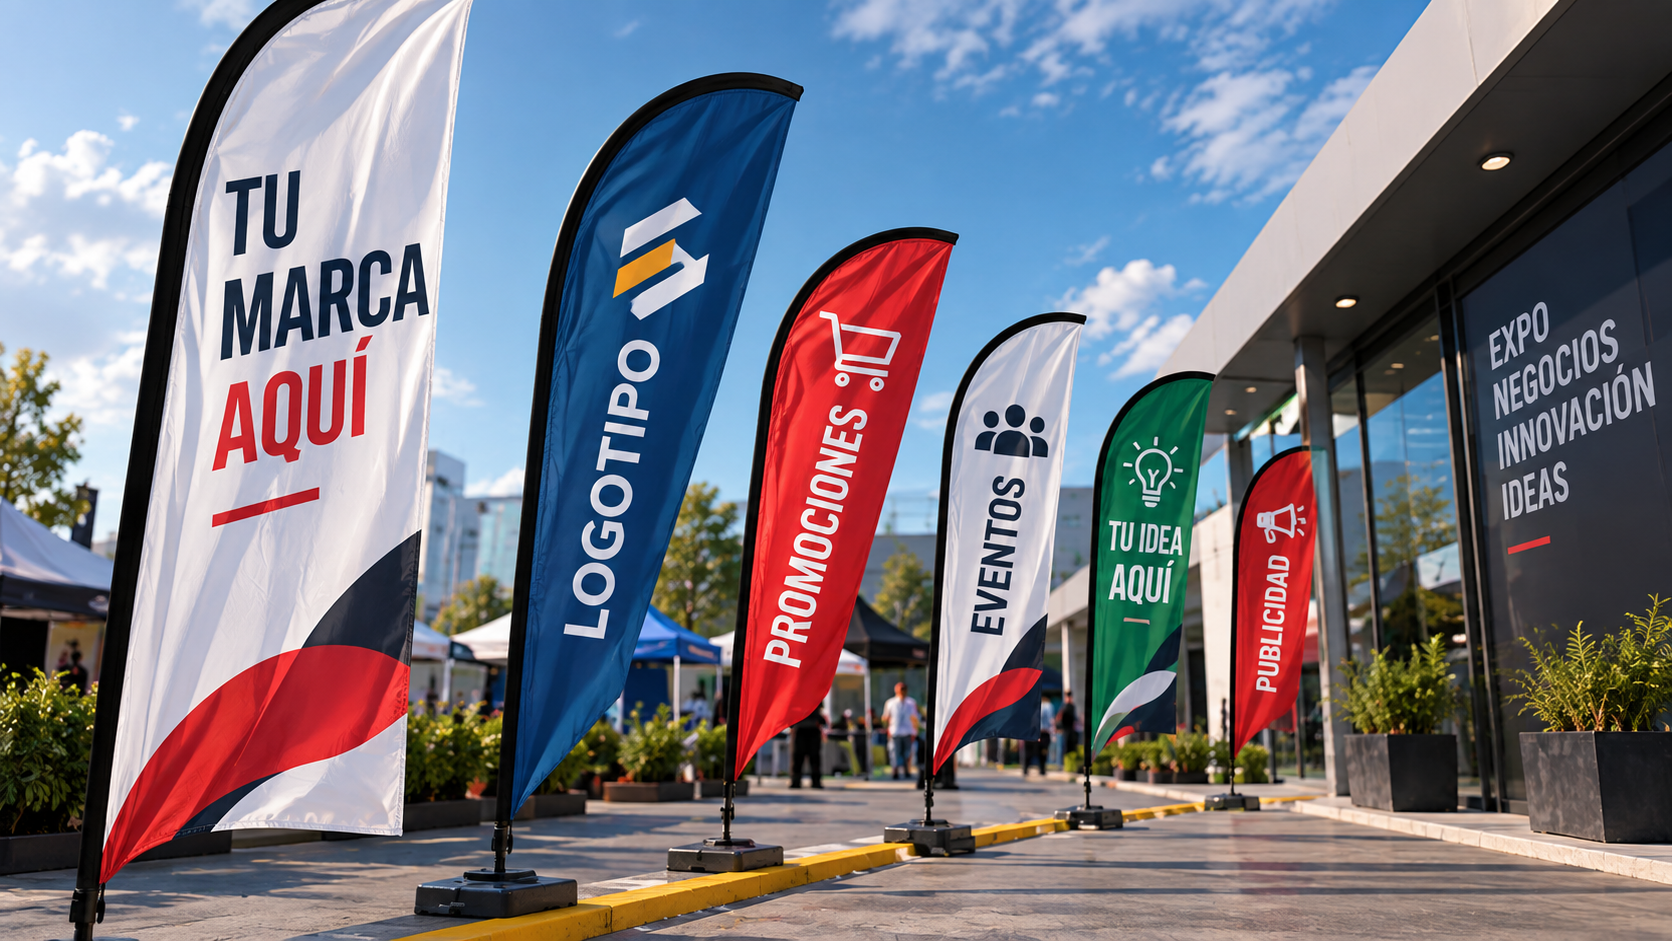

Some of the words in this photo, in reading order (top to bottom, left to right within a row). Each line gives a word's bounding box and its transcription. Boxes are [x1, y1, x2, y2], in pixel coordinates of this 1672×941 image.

[225, 170, 301, 256] TU
[220, 242, 430, 361] MARCA
[1488, 301, 1549, 371] EXPO
[212, 334, 373, 472] AQUÍ
[1493, 318, 1619, 420] NEGOCIOS
[1497, 361, 1656, 470] INNOVACIÓN
[563, 339, 660, 640] LOGOTIPO
[763, 404, 868, 669] PROMOCIONES
[1108, 520, 1134, 552] TU
[1138, 523, 1183, 556] IDEA
[1501, 460, 1570, 521] IDEAS
[970, 475, 1026, 636] EVENTOS
[1108, 559, 1175, 605] AQUÍ
[1255, 554, 1290, 693] PUBLICIDAD
